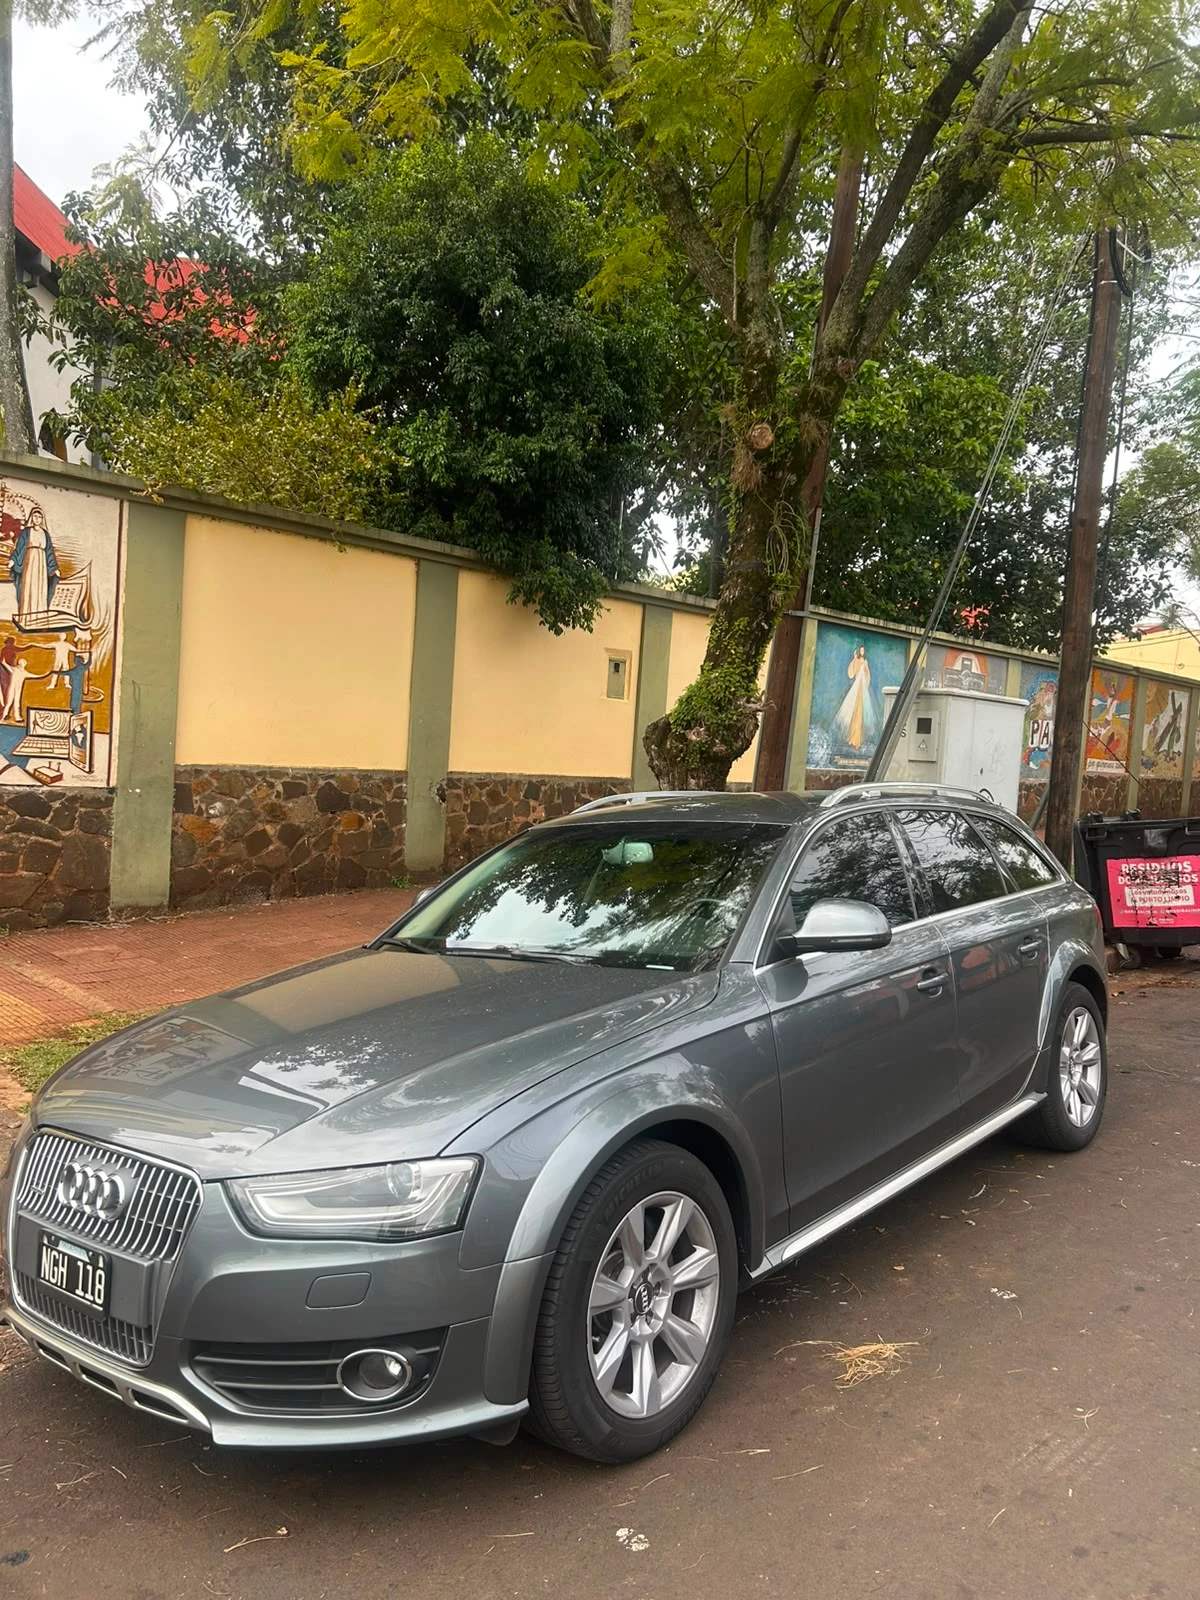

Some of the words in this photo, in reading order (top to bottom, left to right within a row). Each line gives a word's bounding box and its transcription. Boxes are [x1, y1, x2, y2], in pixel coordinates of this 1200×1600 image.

[1030, 720, 1050, 745] PA
[40, 1245, 68, 1288] NGH
[75, 1260, 105, 1304] 118
